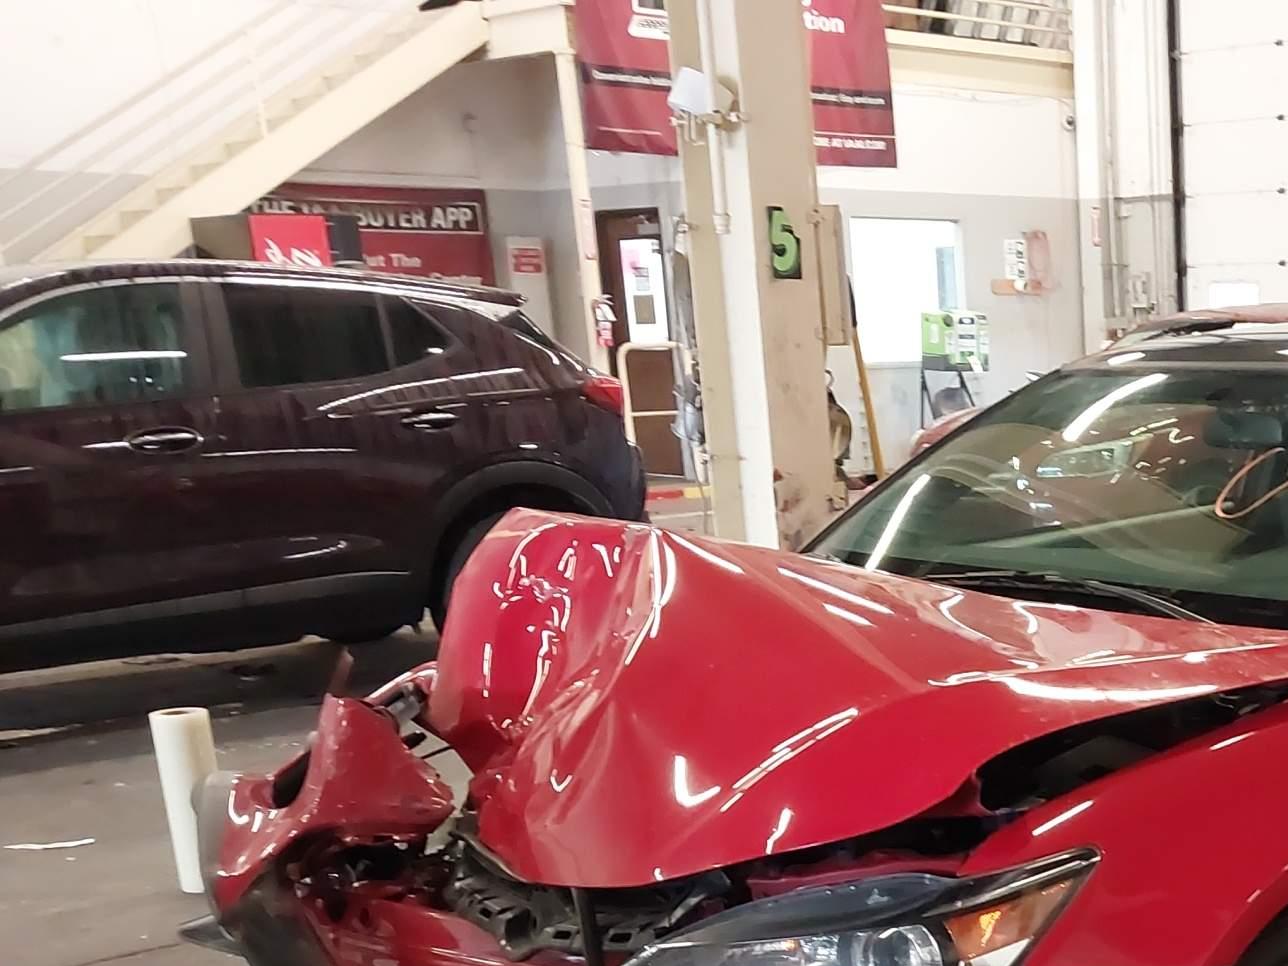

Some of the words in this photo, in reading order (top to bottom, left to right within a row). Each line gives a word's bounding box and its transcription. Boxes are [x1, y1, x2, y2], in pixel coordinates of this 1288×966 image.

[430, 206, 473, 230] APP
[769, 208, 799, 275] 5
[388, 253, 422, 269] The
